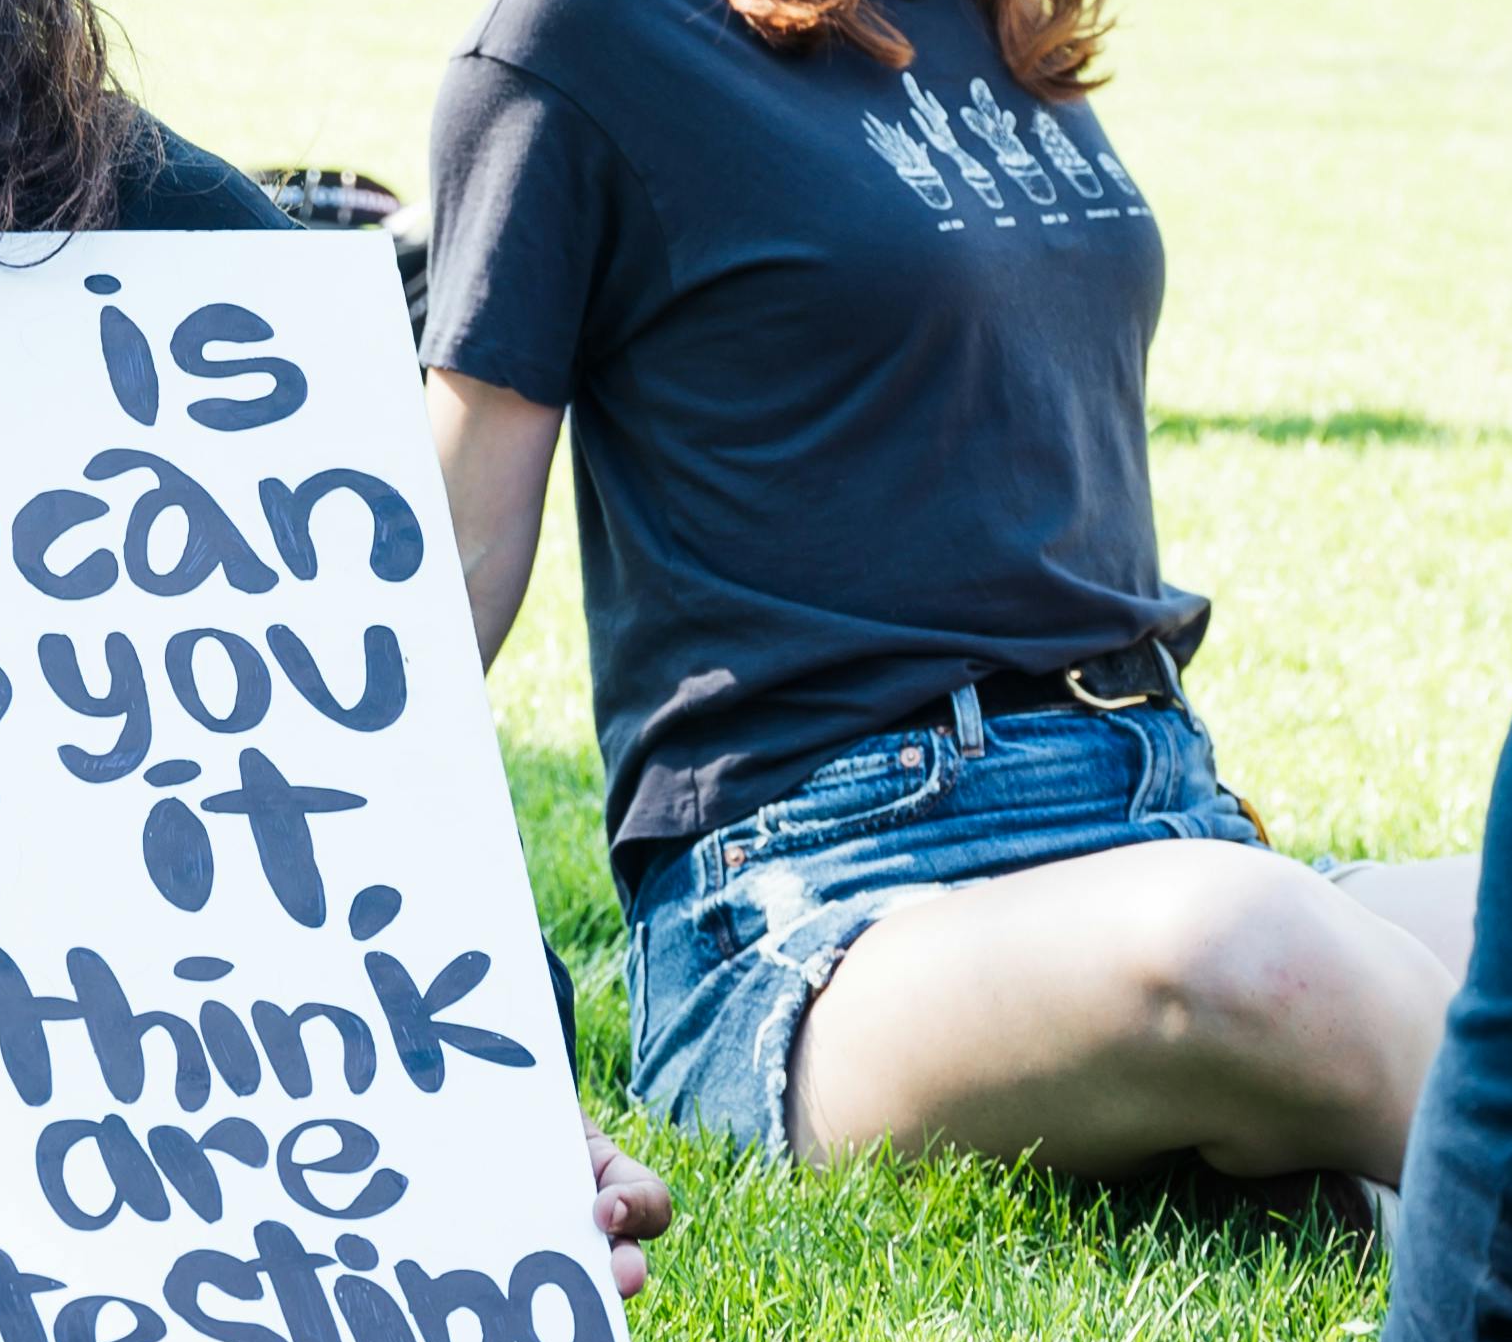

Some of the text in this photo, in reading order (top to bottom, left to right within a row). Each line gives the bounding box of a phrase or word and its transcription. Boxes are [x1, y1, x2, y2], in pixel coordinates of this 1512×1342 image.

[83, 274, 307, 432] is
[38, 624, 407, 783] you
[36, 1114, 408, 1231] are
